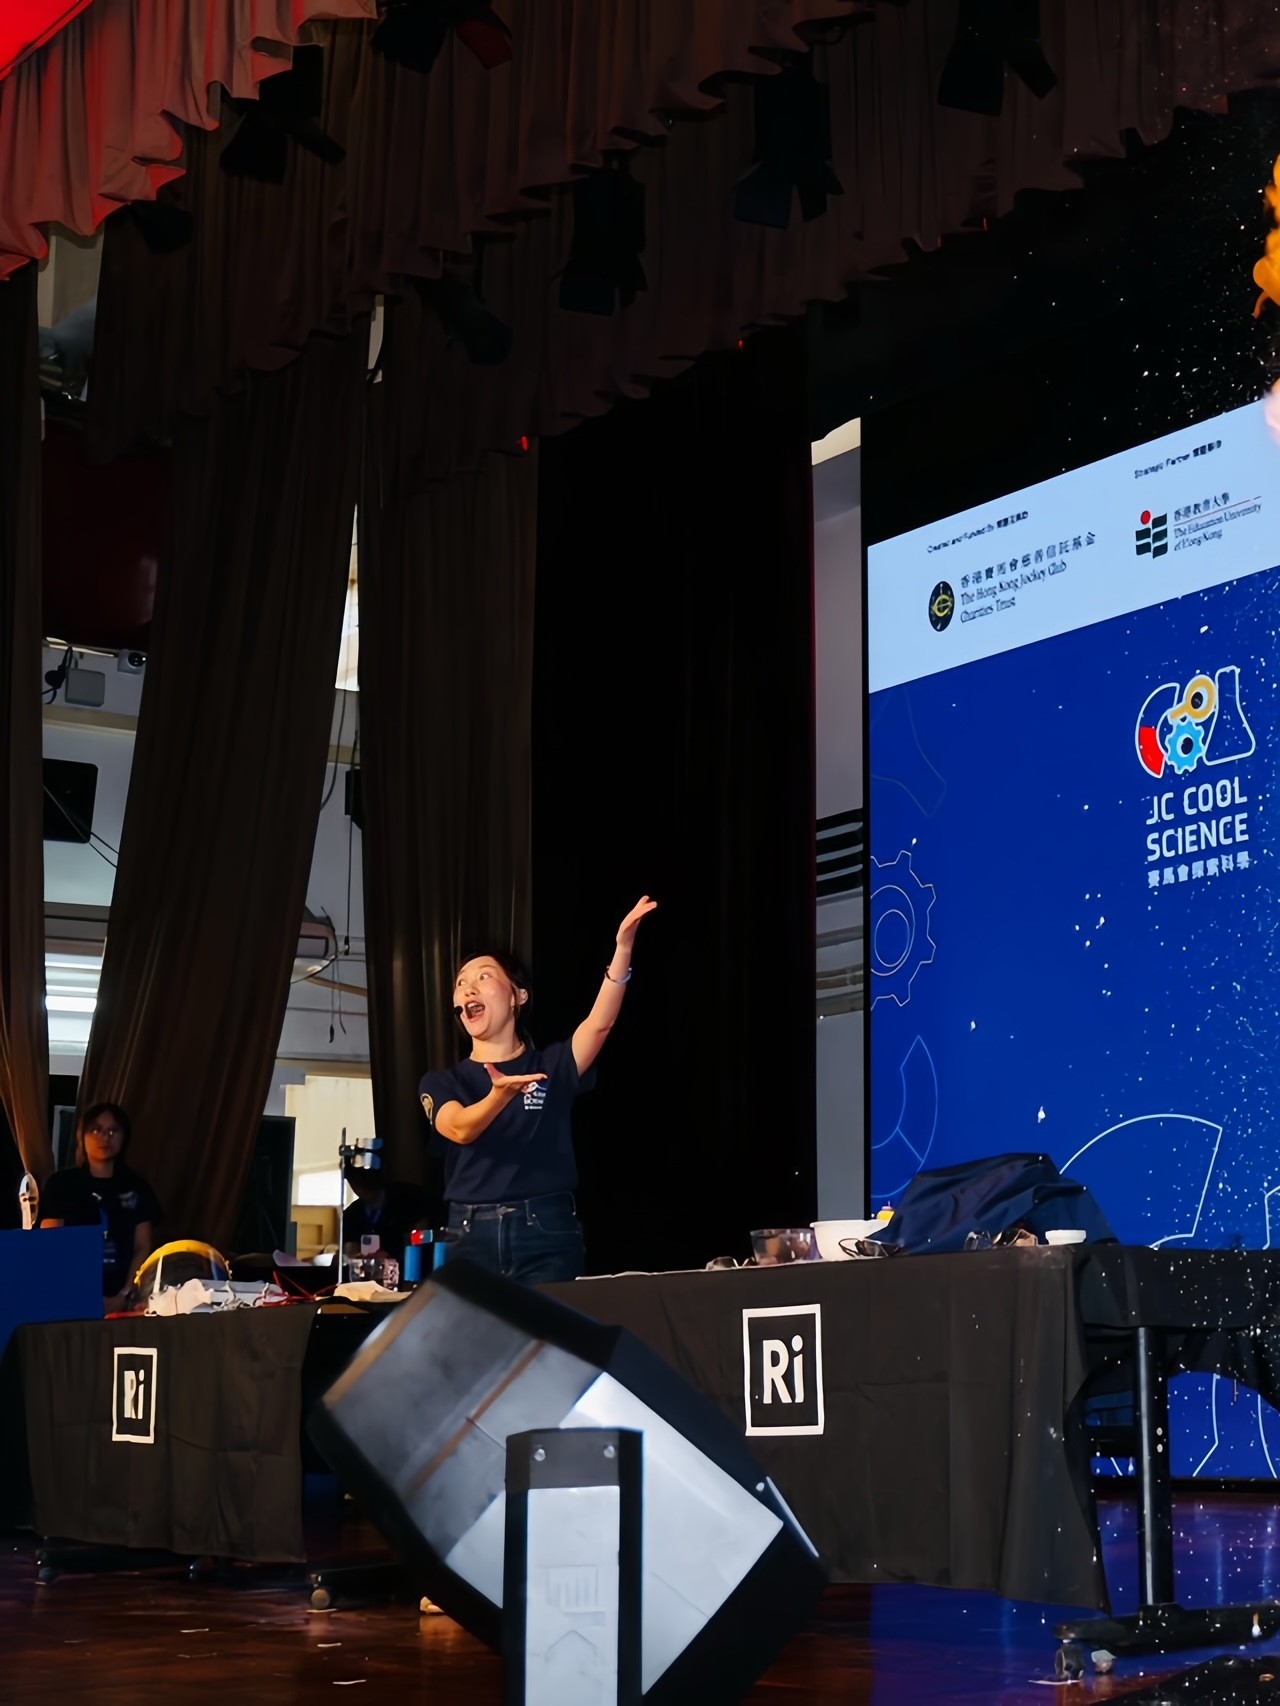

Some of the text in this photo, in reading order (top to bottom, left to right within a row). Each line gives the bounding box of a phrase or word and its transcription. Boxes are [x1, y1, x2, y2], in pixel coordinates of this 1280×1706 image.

[1146, 776, 1248, 825] JC COOL
[1147, 812, 1249, 862] SCIENCE
[123, 1369, 145, 1420] Ri
[762, 1334, 805, 1405] Ri
